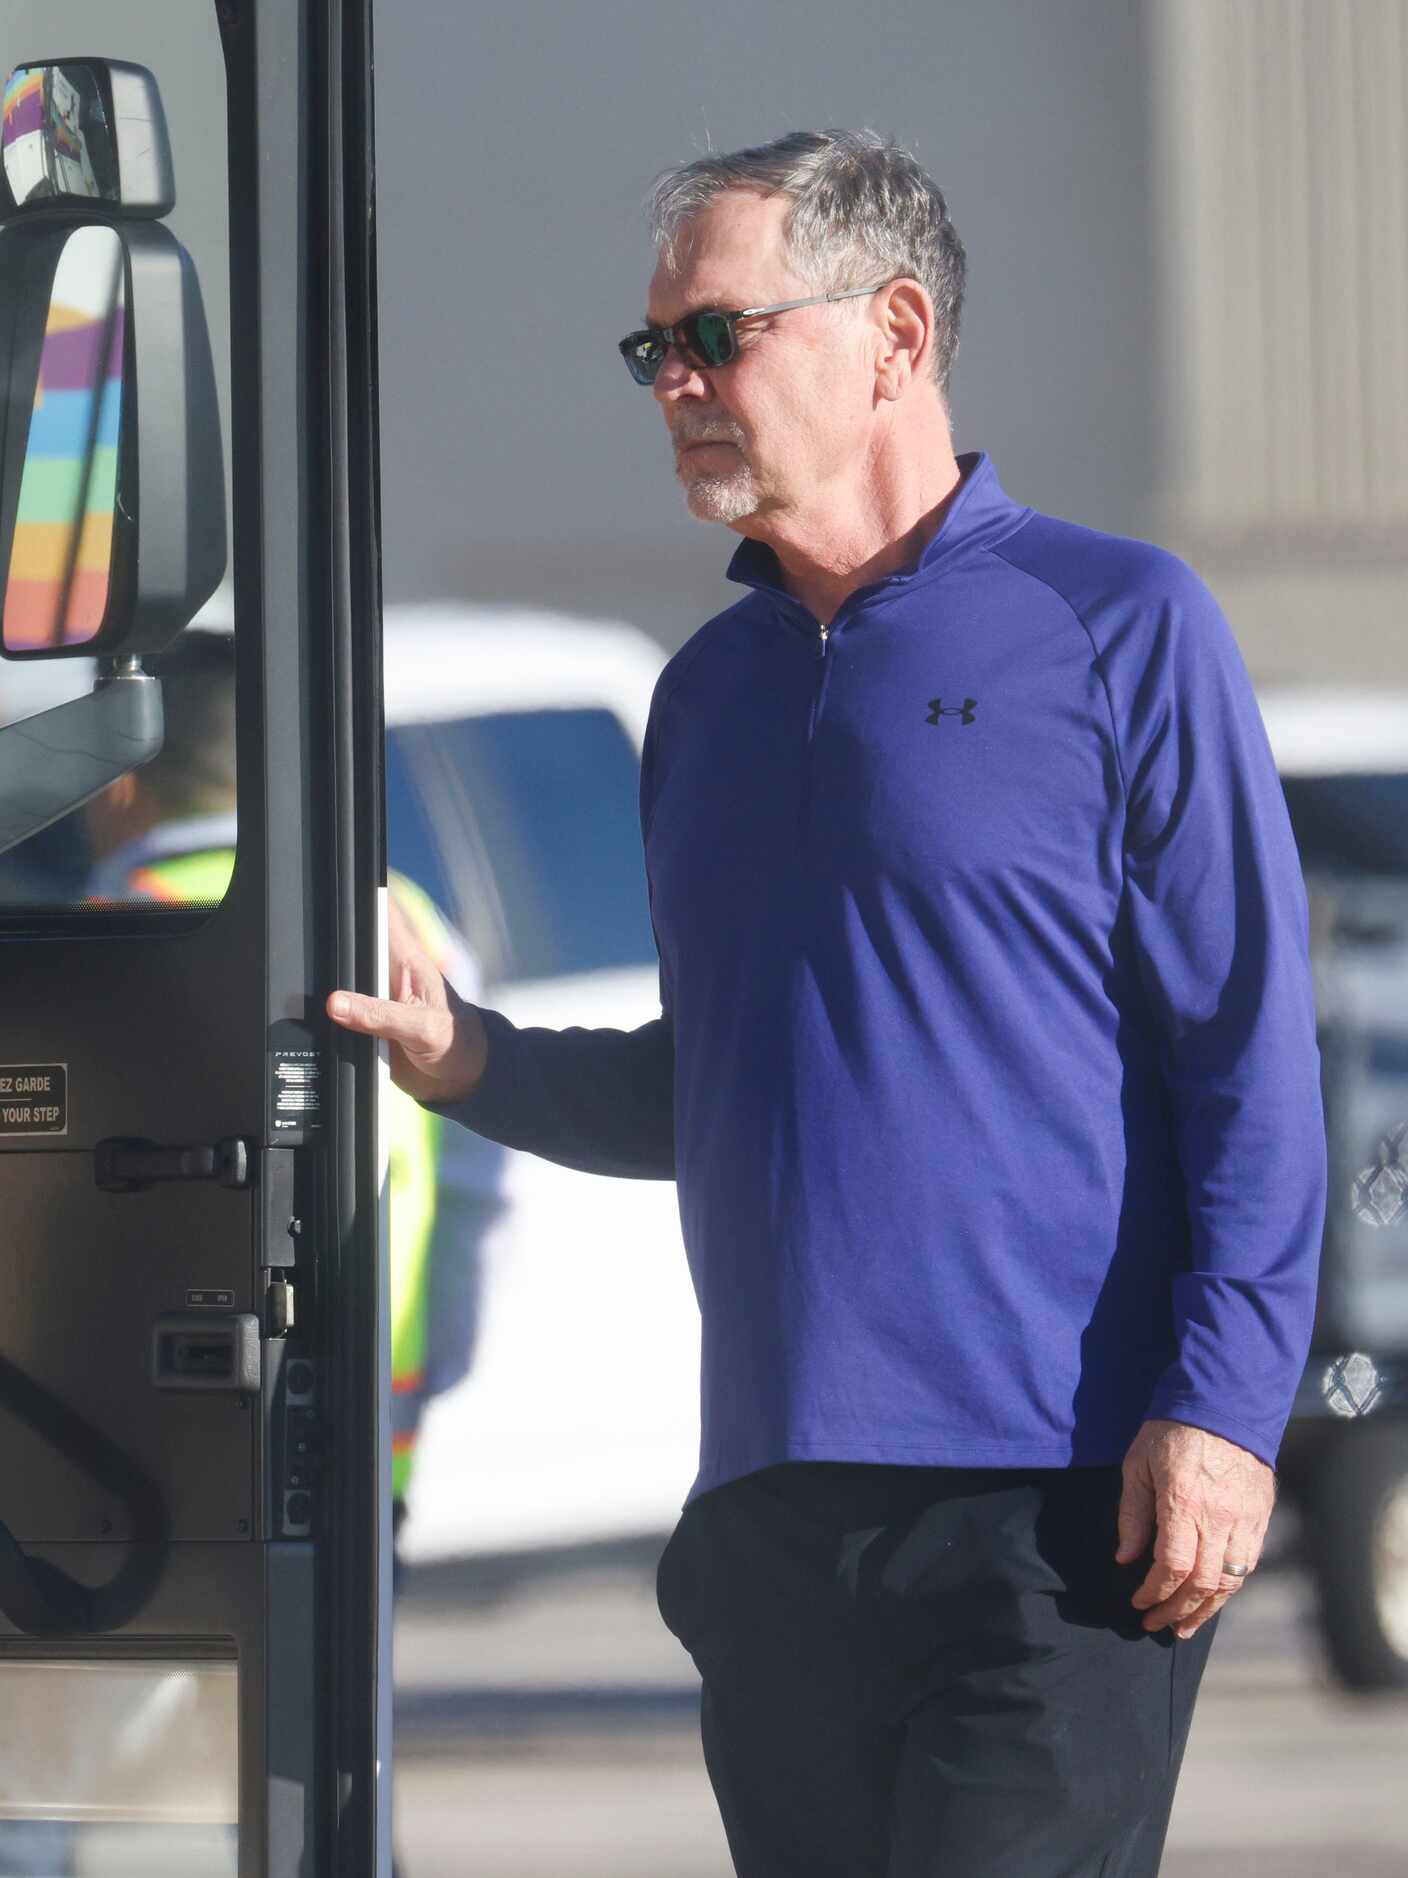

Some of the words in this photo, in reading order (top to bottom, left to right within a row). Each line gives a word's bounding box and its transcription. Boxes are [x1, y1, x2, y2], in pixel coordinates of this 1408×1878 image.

[15, 1076, 51, 1092] GARDE
[2, 1107, 31, 1123] YOUR
[33, 1106, 60, 1122] STEP
